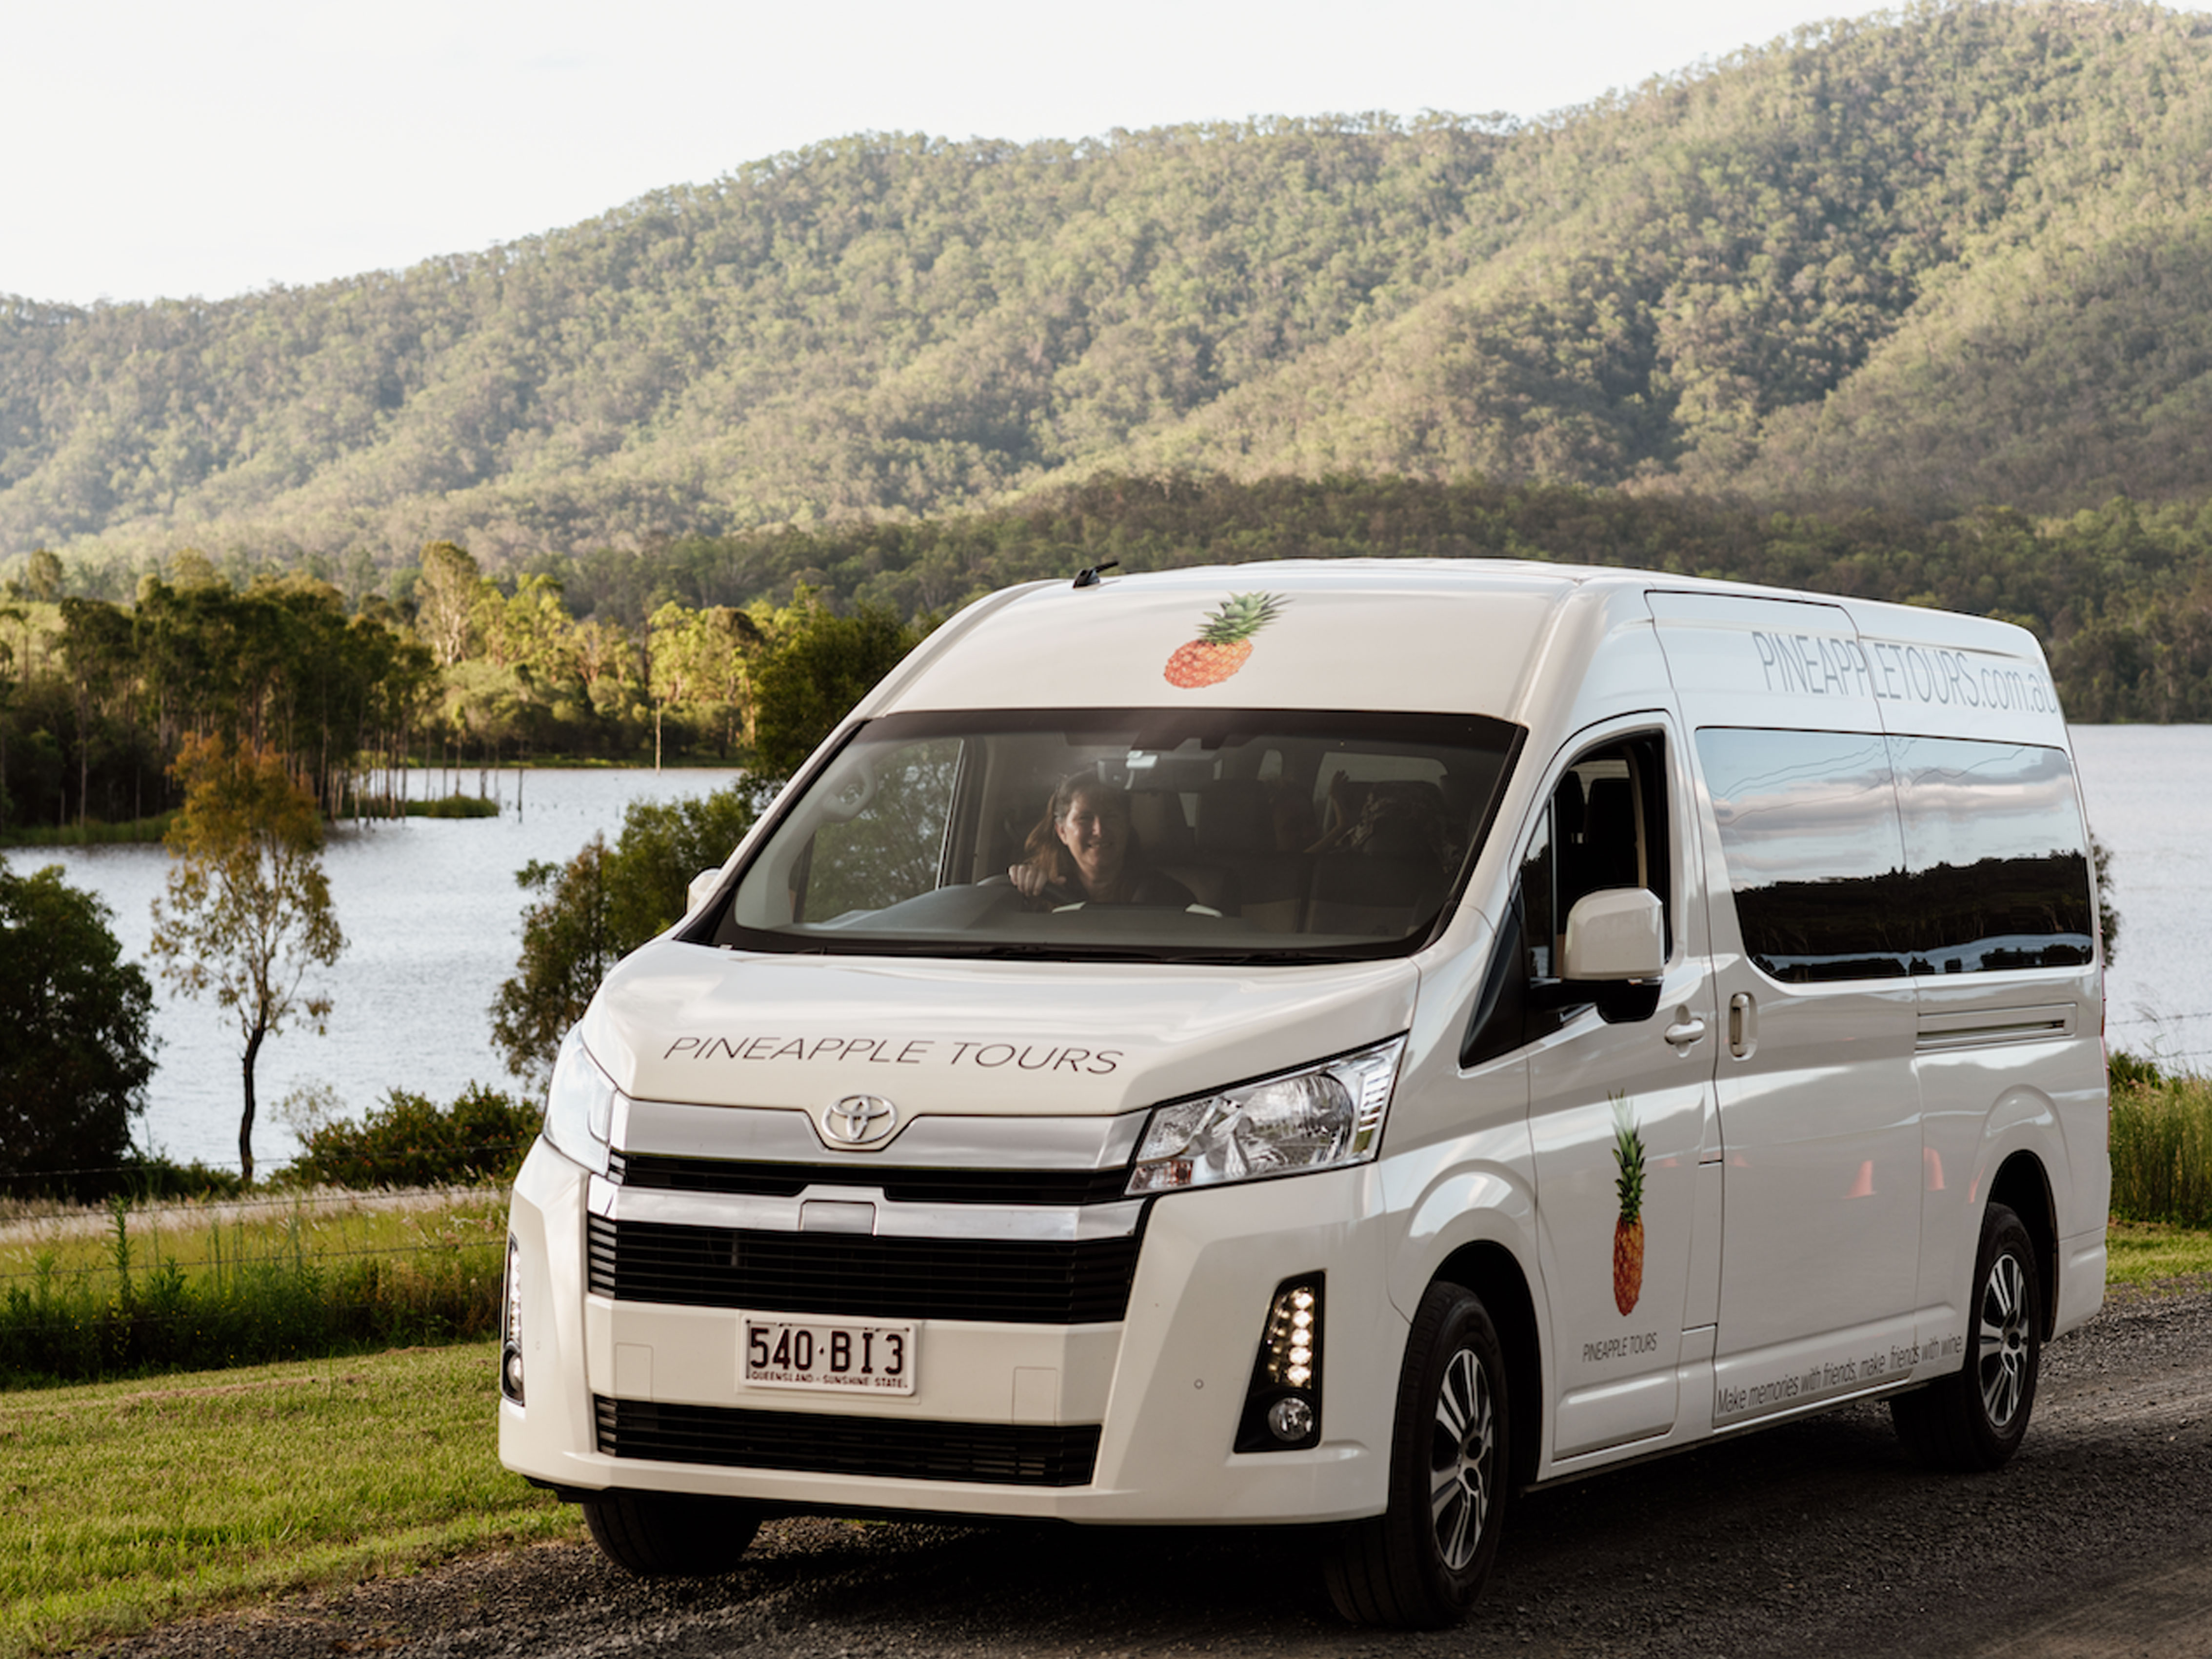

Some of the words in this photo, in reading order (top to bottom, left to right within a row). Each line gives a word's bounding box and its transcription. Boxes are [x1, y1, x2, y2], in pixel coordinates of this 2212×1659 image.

[1752, 631, 2057, 714] PINEAPPLETOURS.com.au
[663, 1036, 935, 1064] PINEAPPLE
[951, 1041, 1124, 1075] TOURS
[1582, 1337, 1627, 1363] PINEAPPLE
[1630, 1332, 1657, 1354] TOURS
[751, 1371, 814, 1382] QUEENSLAND
[822, 1374, 870, 1386] SUNSHINE
[1717, 1385, 1747, 1415] Make
[1749, 1374, 1799, 1407] memories
[1800, 1366, 1821, 1393] with
[1859, 1352, 1886, 1379] make
[1890, 1344, 1919, 1369] friends
[1922, 1336, 1939, 1362] with
